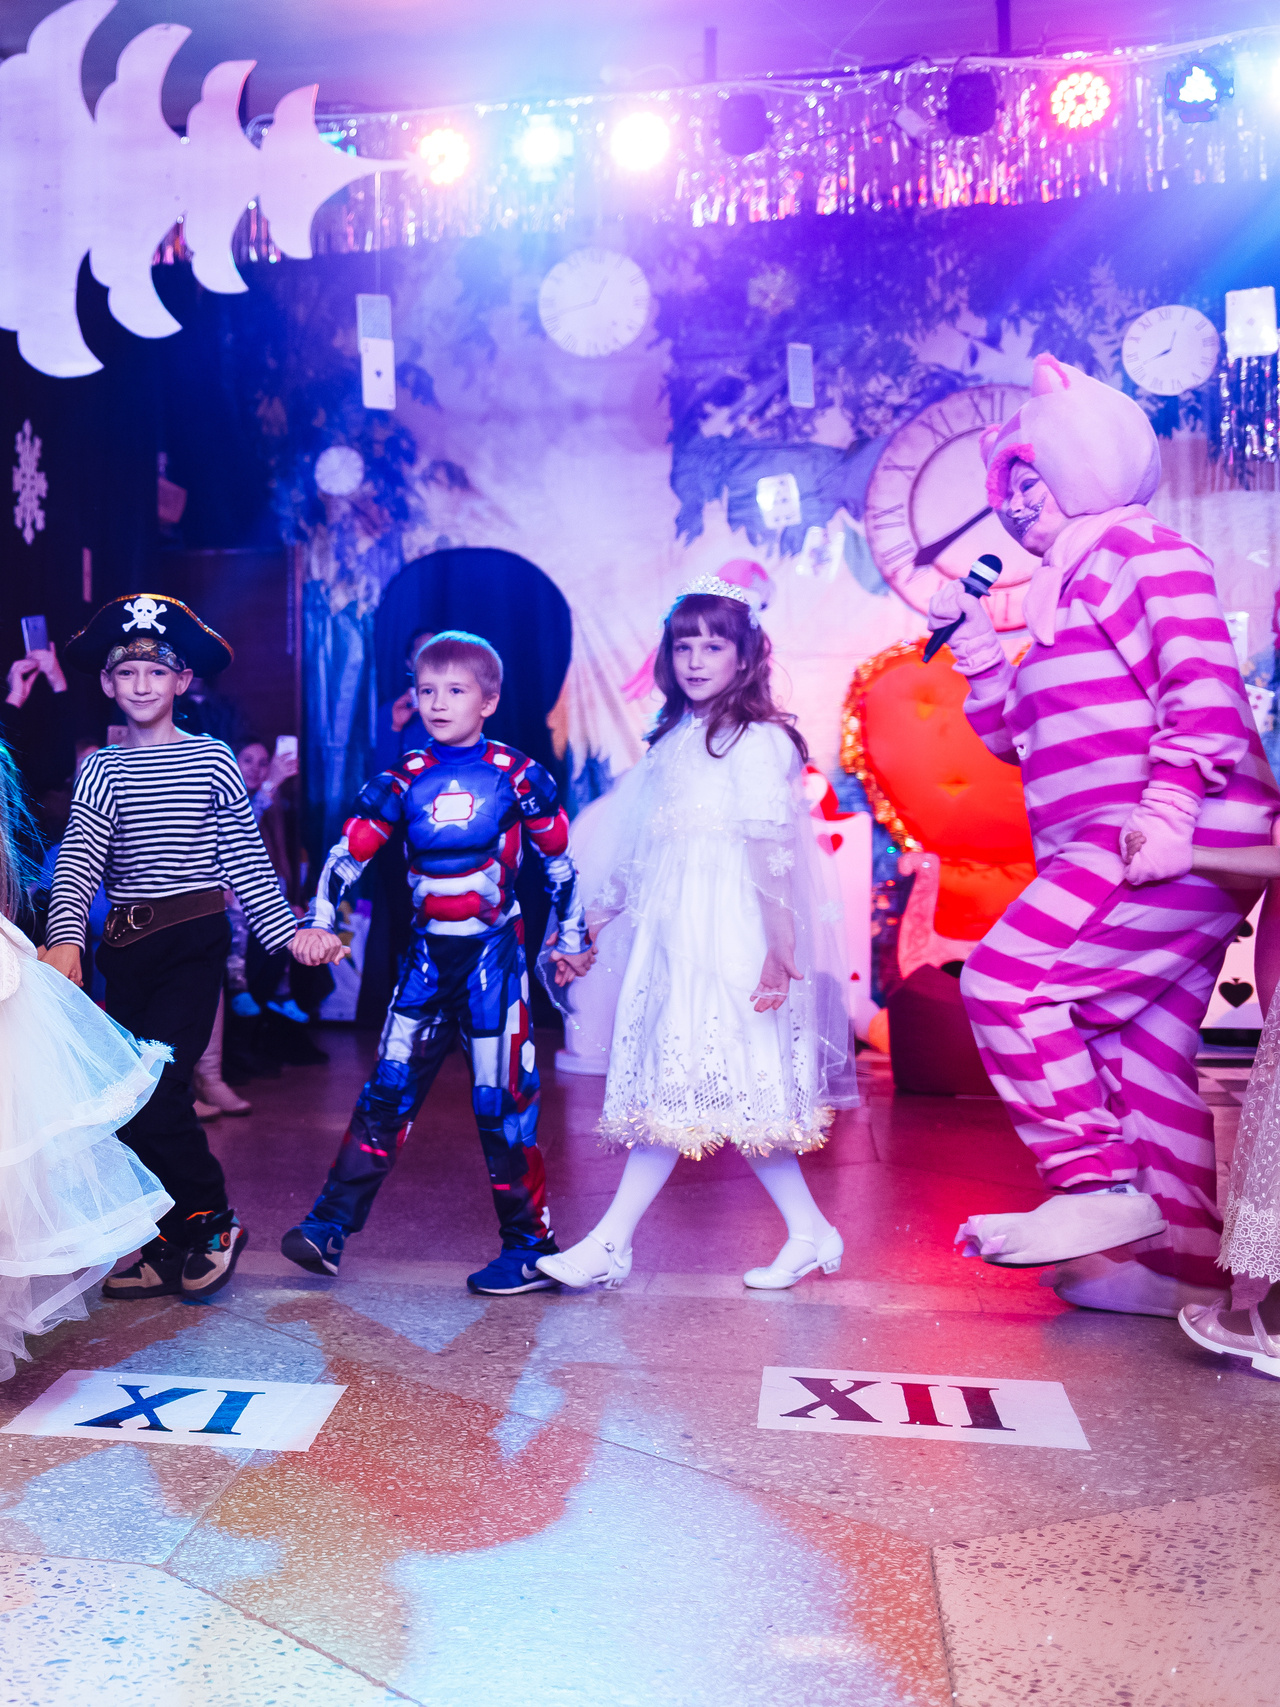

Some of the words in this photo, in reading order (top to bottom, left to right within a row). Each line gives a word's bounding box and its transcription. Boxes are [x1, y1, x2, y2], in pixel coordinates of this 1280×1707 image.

[919, 408, 955, 444] XI
[969, 389, 1007, 424] XII
[73, 1383, 266, 1436] XI
[779, 1376, 1017, 1432] XII
